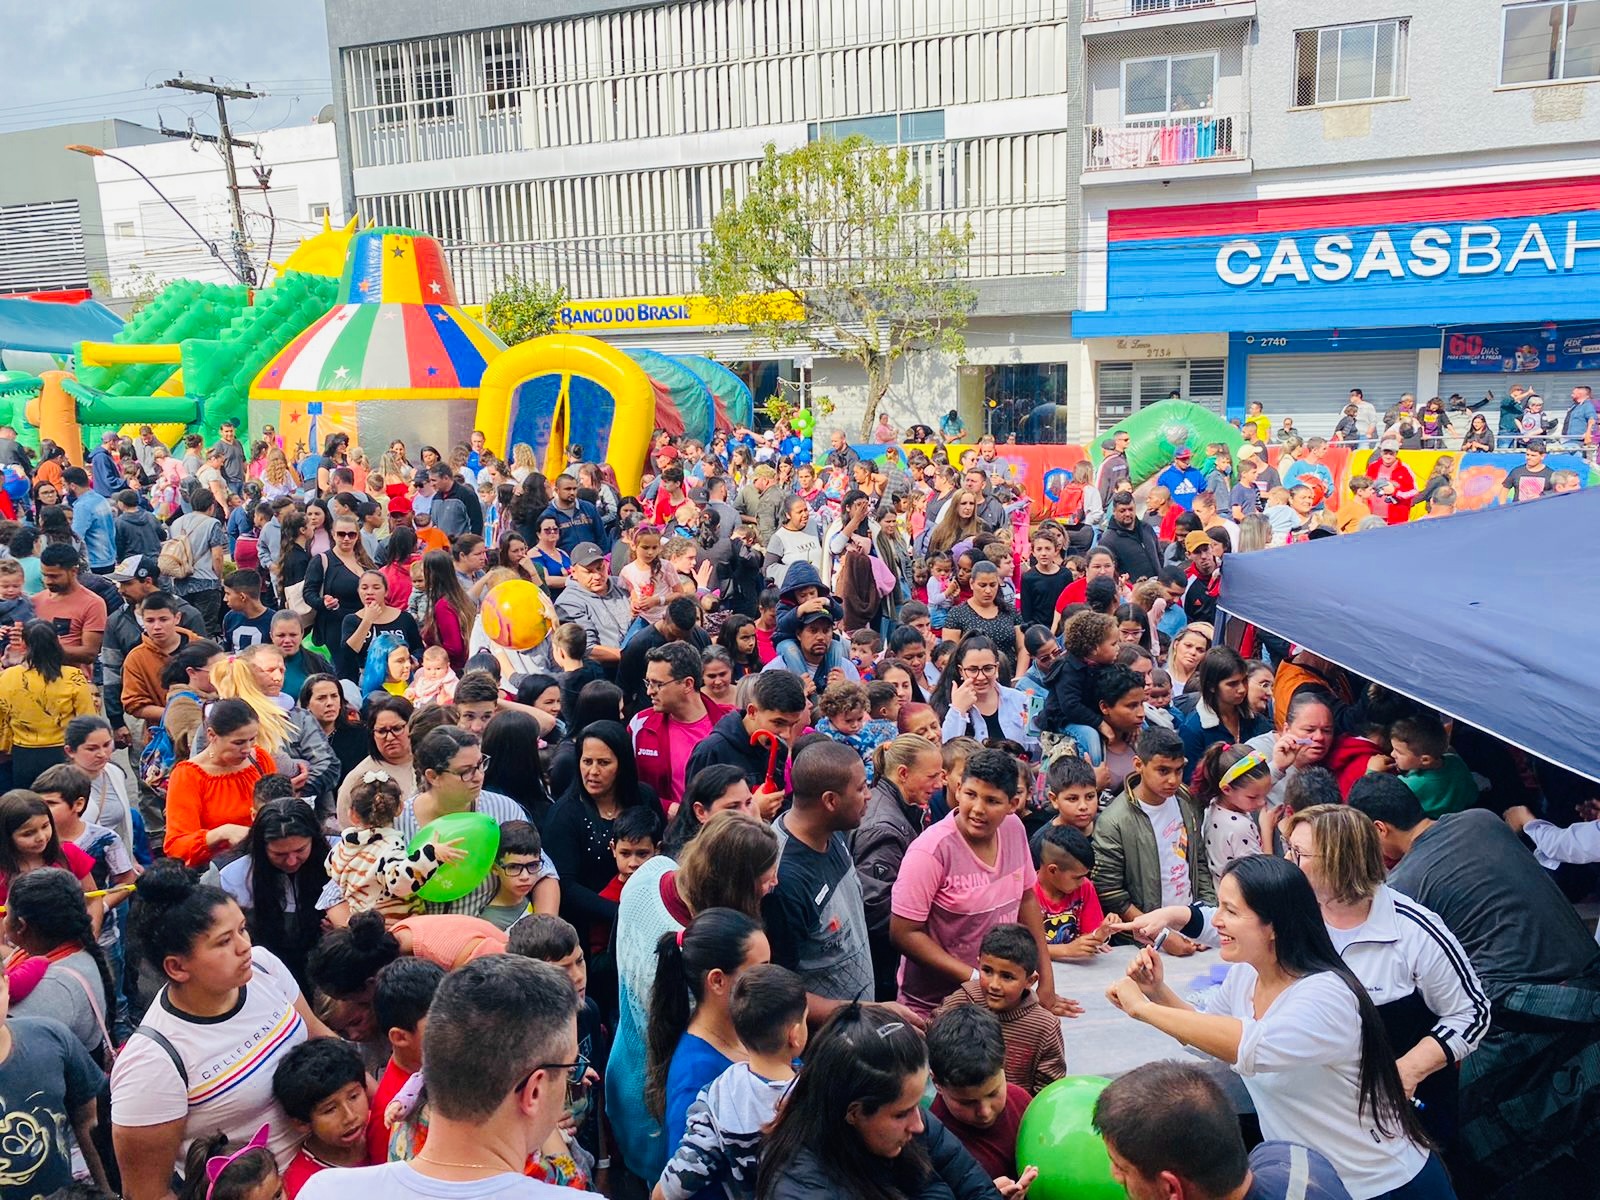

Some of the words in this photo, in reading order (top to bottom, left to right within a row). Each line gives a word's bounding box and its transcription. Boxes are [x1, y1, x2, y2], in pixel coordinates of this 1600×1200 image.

[561, 307, 613, 323] BANCO
[615, 307, 635, 322] DO
[637, 303, 690, 321] BRASIL
[1260, 337, 1288, 347] 2740
[1449, 333, 1483, 356] 60
[1480, 346, 1500, 355] DIAS
[1146, 348, 1171, 358] 2734
[941, 871, 991, 891] DENIM
[201, 1011, 281, 1080] CALIFORNIA
